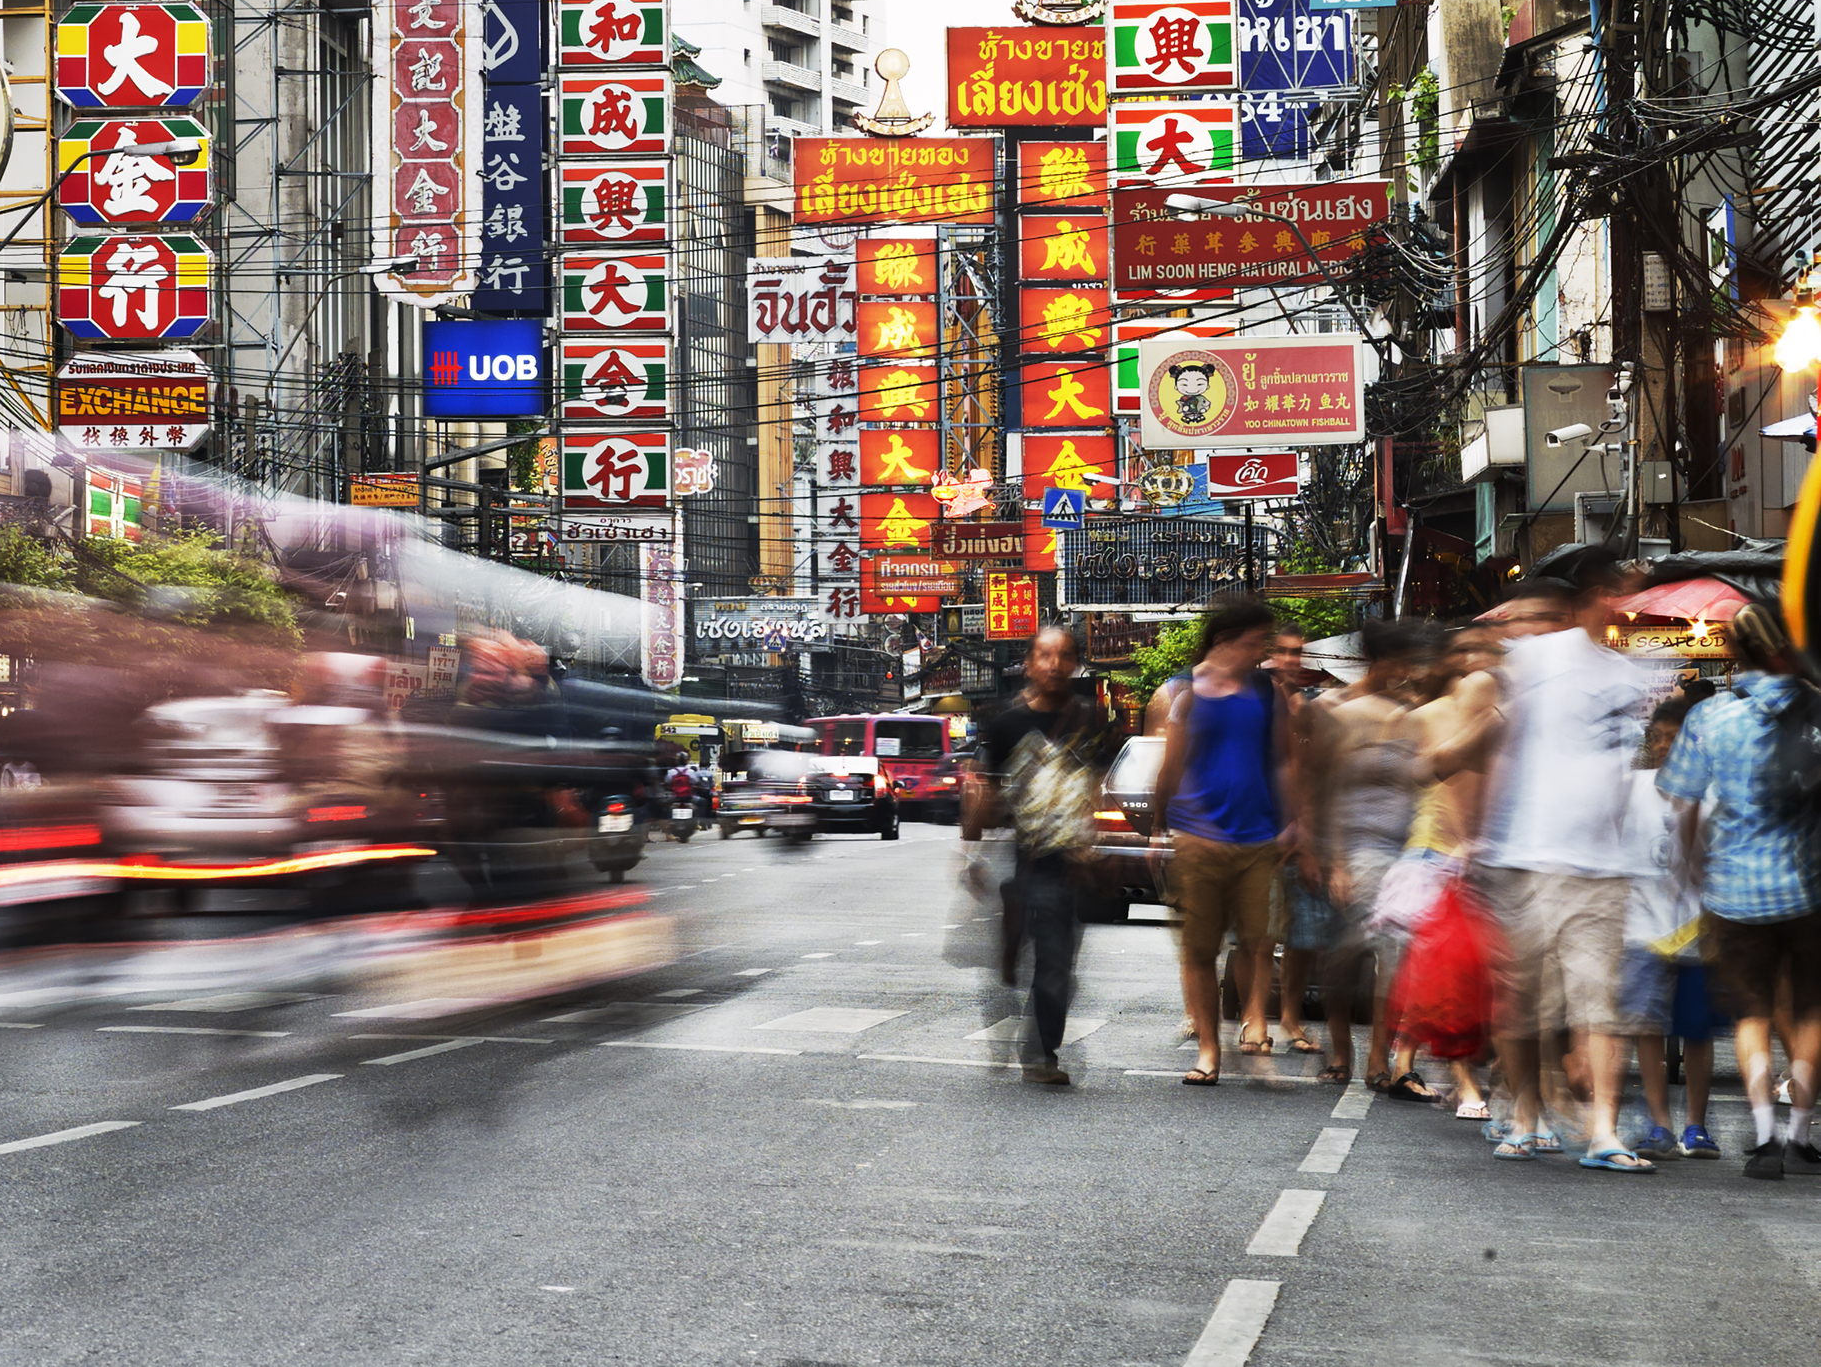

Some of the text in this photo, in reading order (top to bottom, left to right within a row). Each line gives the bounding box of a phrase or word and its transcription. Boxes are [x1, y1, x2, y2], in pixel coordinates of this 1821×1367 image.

[484, 100, 531, 296] 盤谷銀行
[585, 0, 647, 500] 和成興大金行
[1128, 262, 1302, 280] LIM SOON HENG NATURAL
[468, 353, 539, 381] UOB
[1260, 368, 1348, 390] ลูกชิ้นปลาเยาวราช
[59, 386, 207, 416] EXCHANGE
[1244, 417, 1351, 429] YOO CHINATOWN FISHBALL
